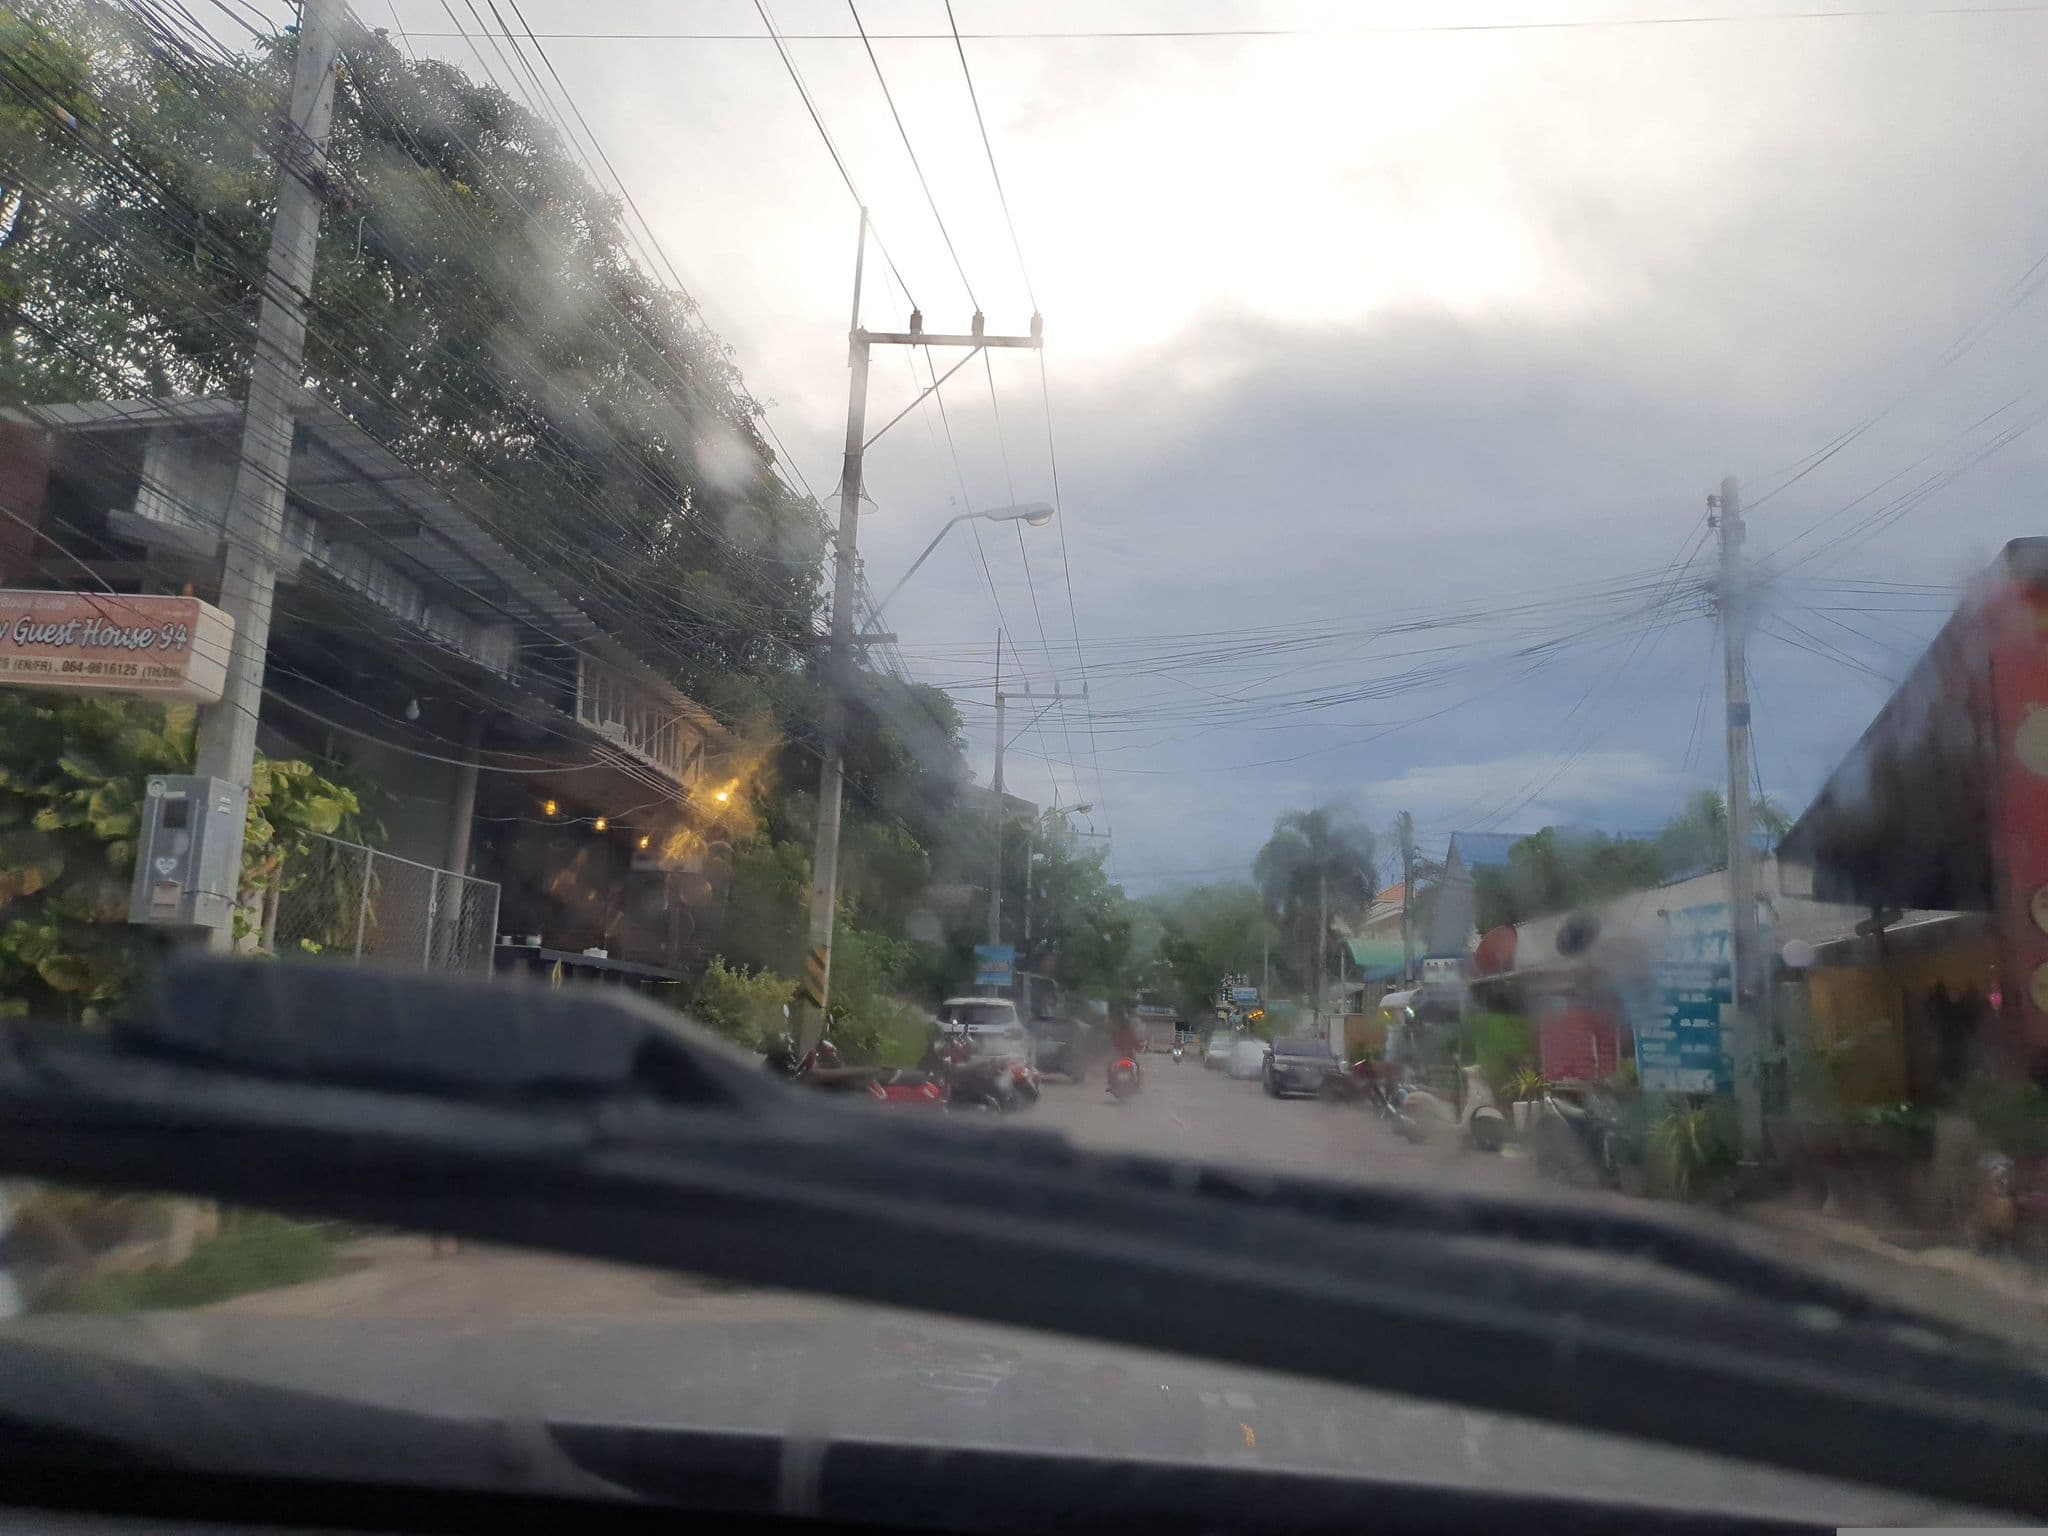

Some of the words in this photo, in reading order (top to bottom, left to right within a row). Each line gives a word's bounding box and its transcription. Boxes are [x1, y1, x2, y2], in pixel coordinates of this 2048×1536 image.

[13, 616, 81, 646] Guest
[82, 618, 157, 650] House
[159, 622, 188, 650] 94
